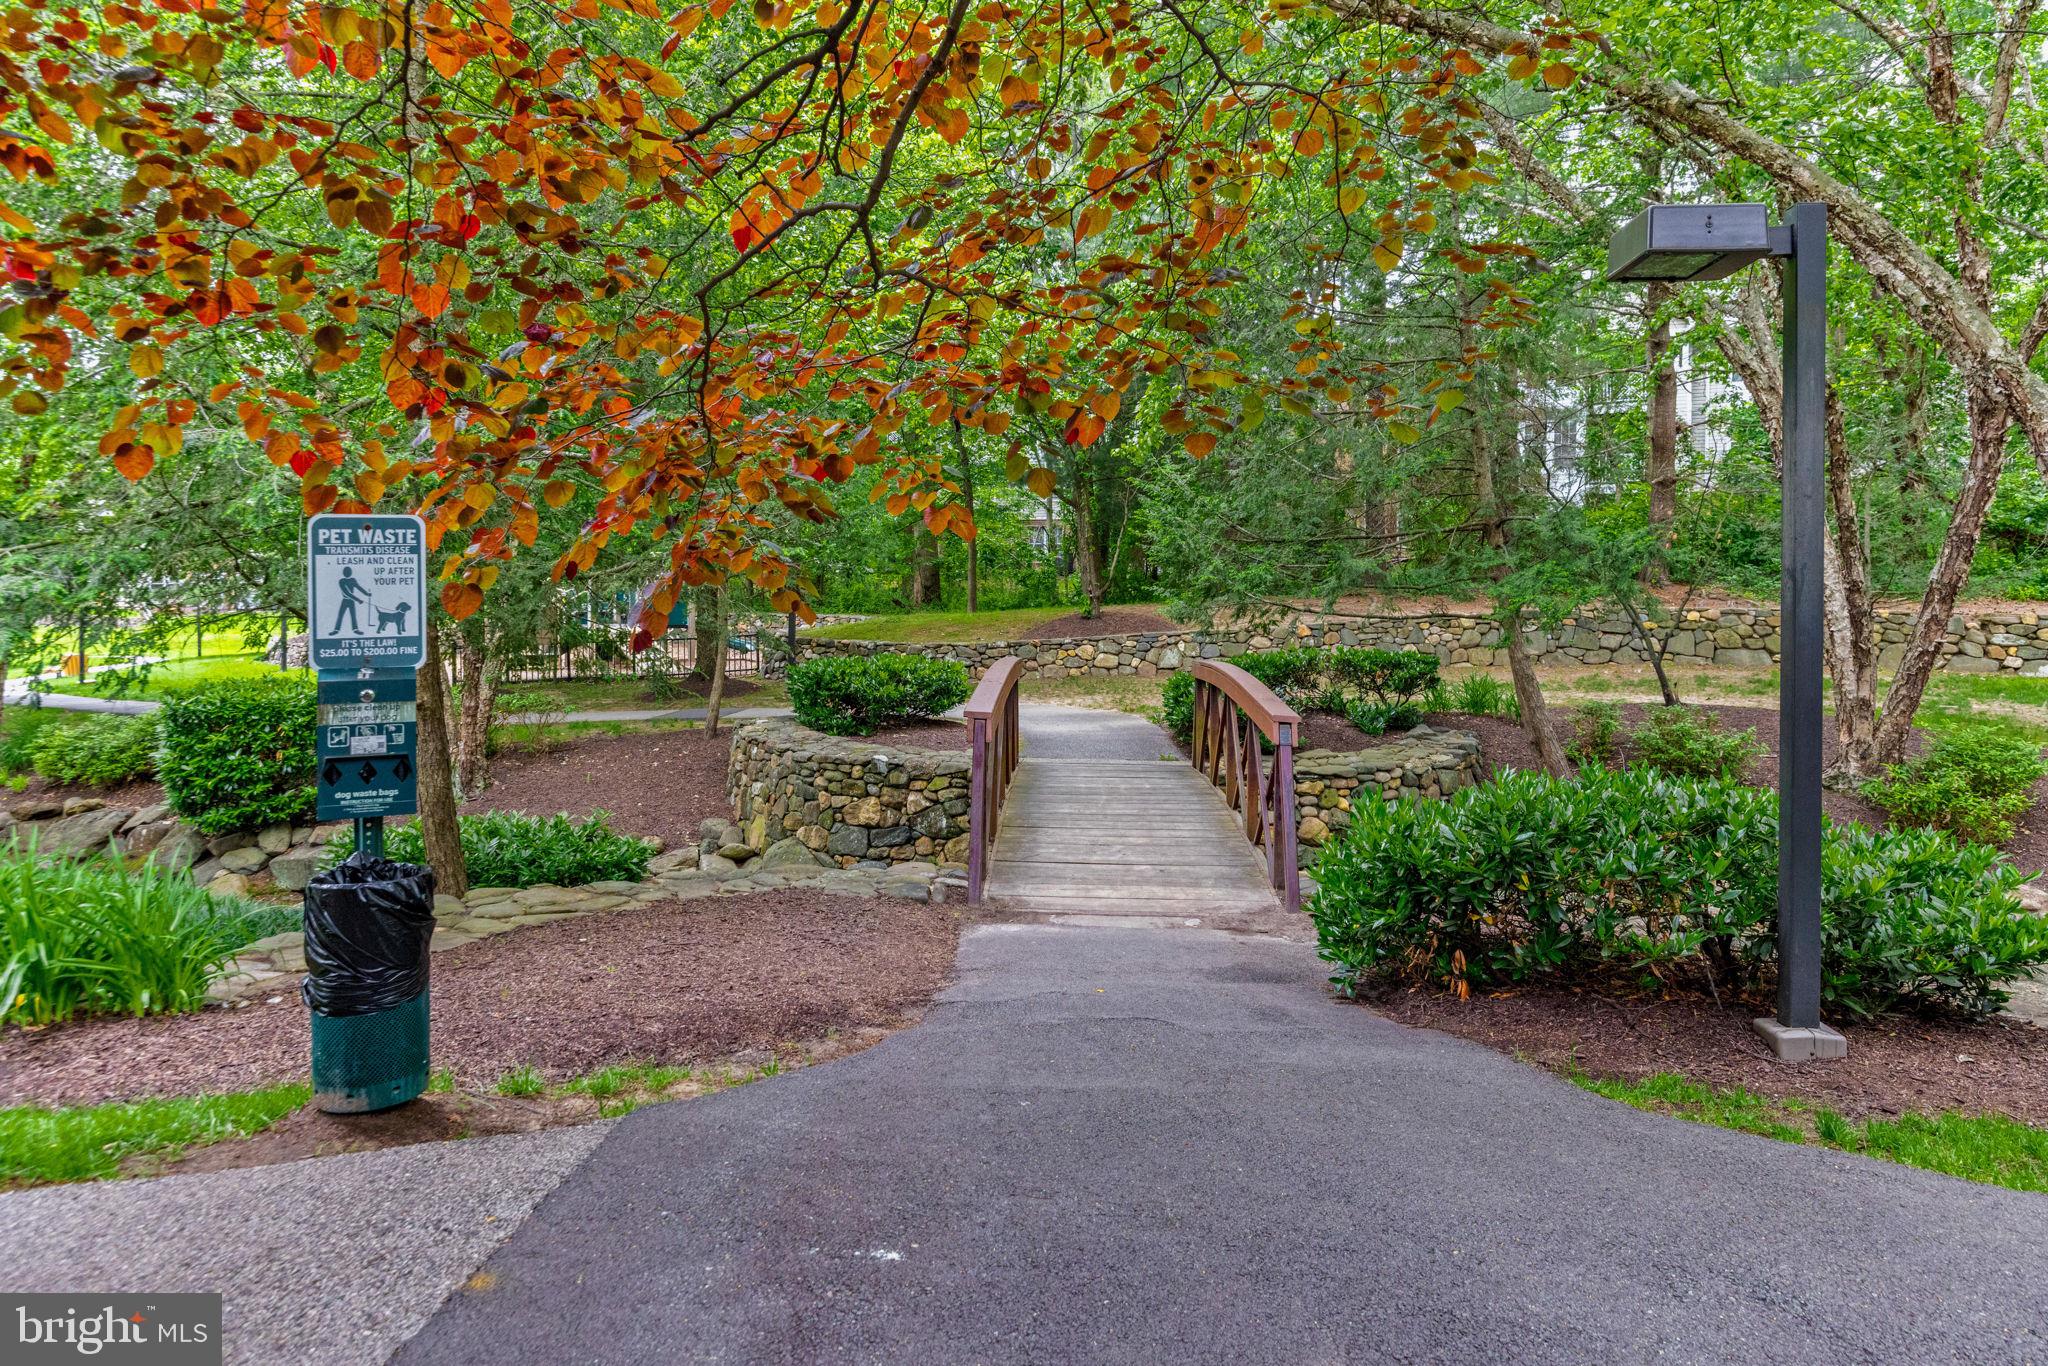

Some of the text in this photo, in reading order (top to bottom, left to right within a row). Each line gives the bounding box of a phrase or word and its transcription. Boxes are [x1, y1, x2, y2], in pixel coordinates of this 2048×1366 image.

[318, 529, 417, 544] PET WASTE
[325, 546, 411, 554] TRANSMITS DISEASE
[337, 557, 414, 565] LEASH AND CLEAN
[374, 567, 415, 575] UP AFTER
[341, 638, 397, 648] IT'S THE LAW!
[319, 646, 418, 657] $25.00 TO $200.00 FINE
[364, 703, 388, 712] clean
[389, 703, 401, 712] up
[334, 791, 352, 800] dog
[378, 788, 399, 797] bags
